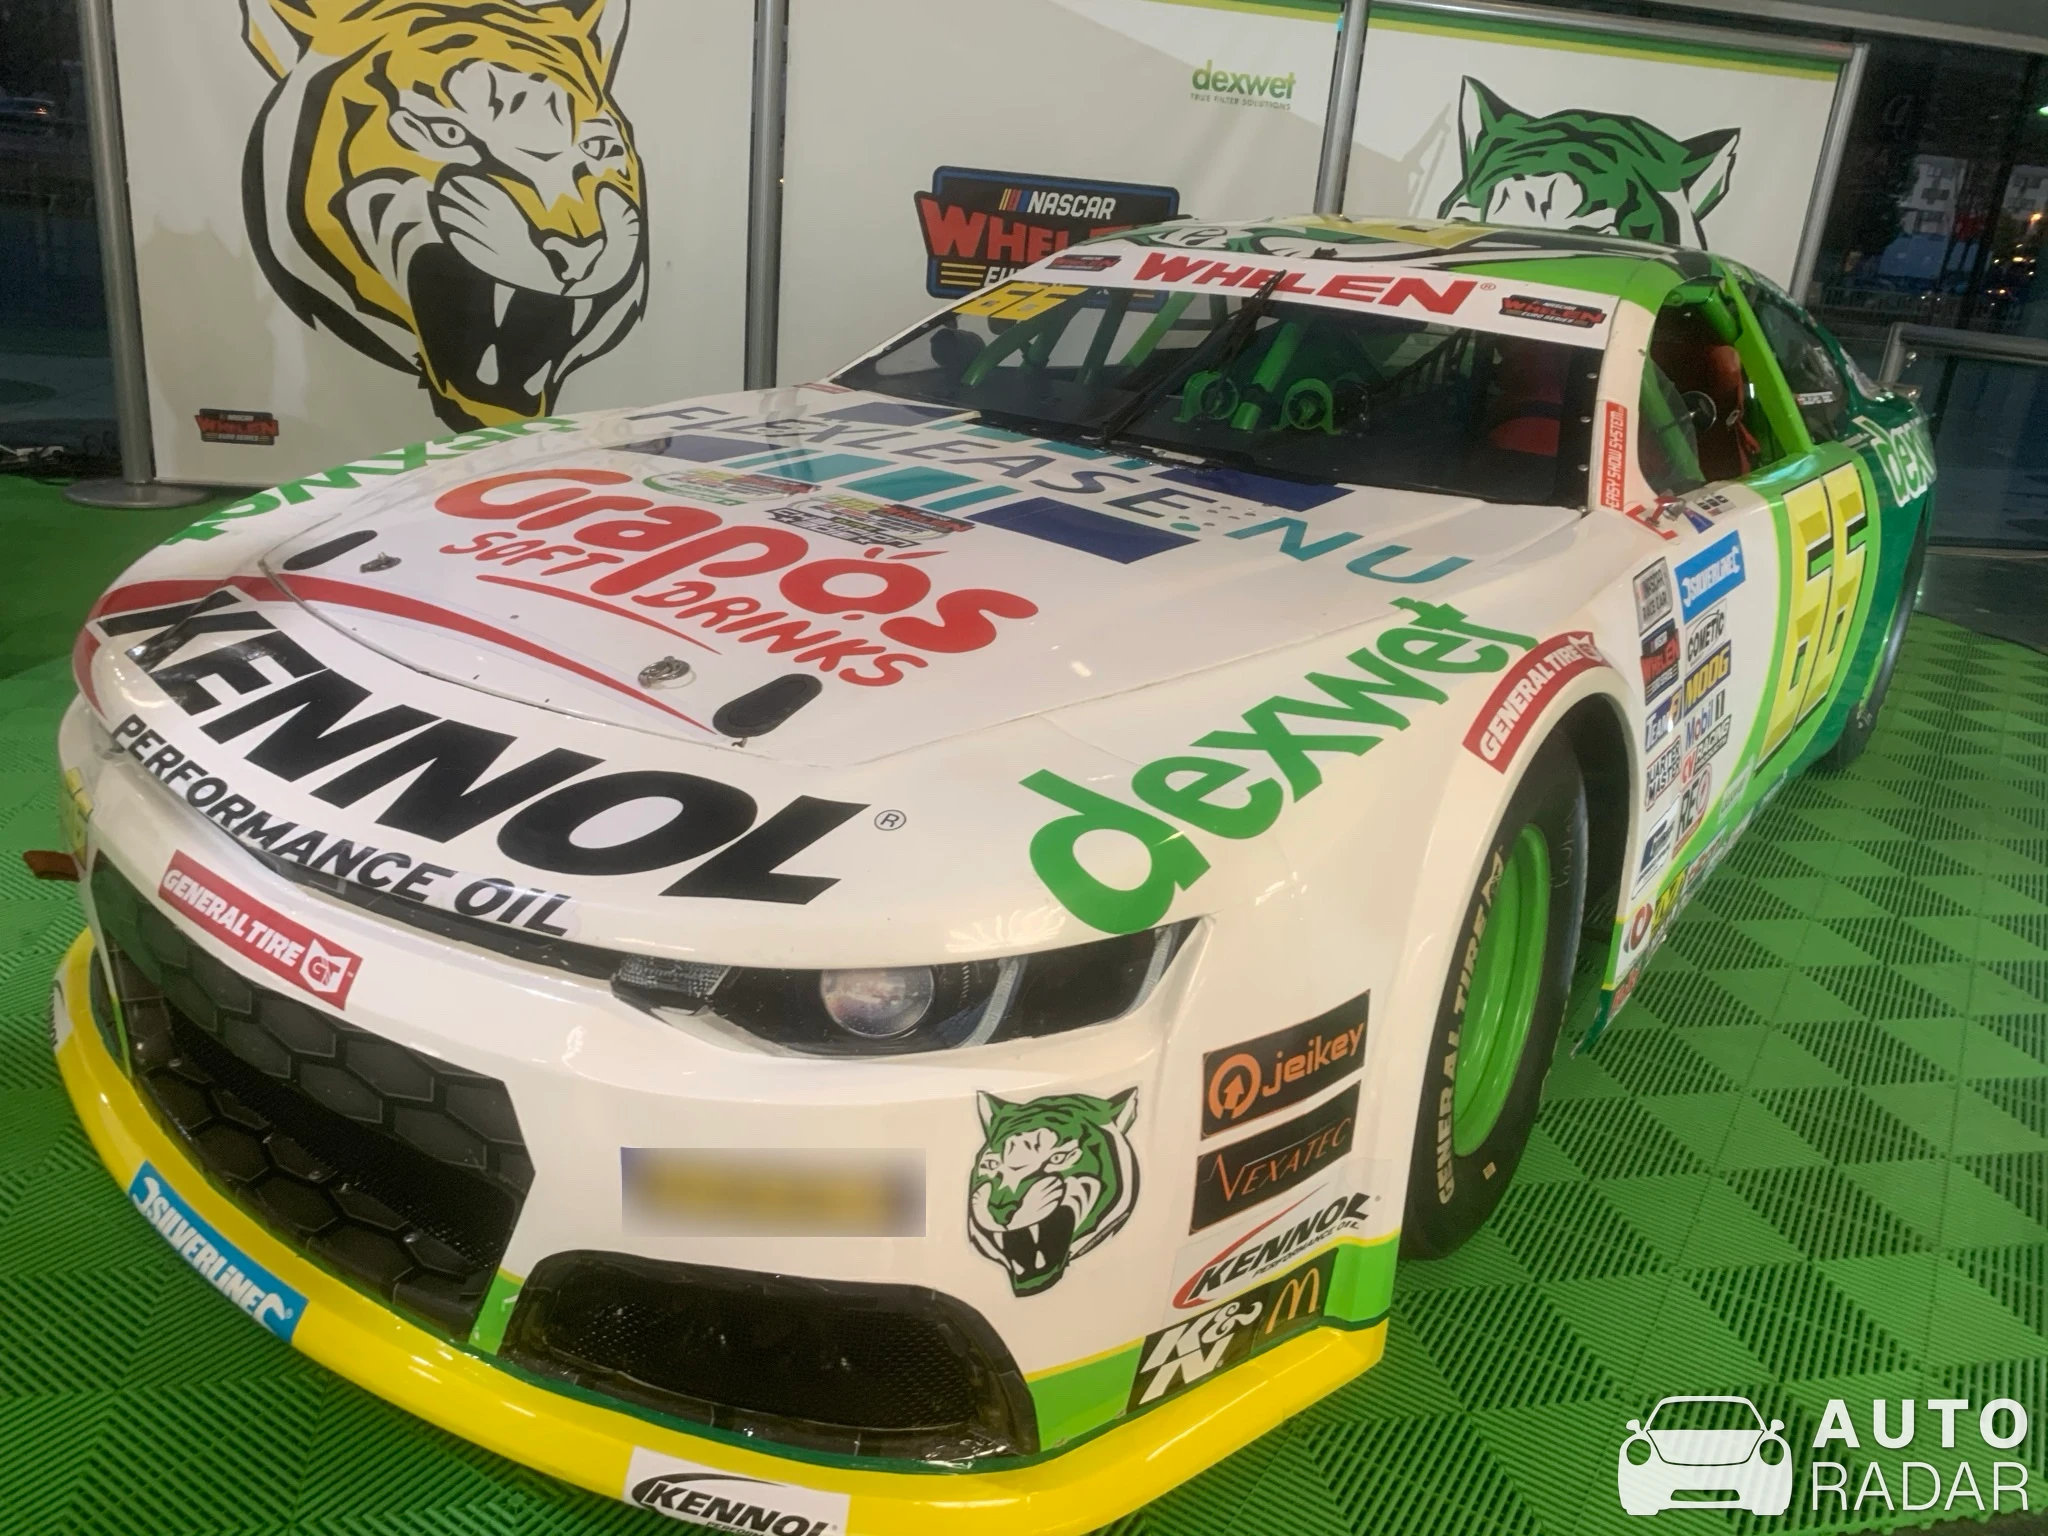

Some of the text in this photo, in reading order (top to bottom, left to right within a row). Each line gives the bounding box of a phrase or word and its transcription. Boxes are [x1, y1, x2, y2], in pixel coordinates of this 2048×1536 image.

[1190, 93, 1291, 111] TRUE FILTER SOLUTIONS
[1192, 59, 1296, 99] dexwet
[920, 197, 1135, 263] WHEL
[1027, 190, 1116, 220] NASCAR
[1133, 252, 1478, 315] WHELEN
[1502, 297, 1606, 324] WHELEN
[1609, 409, 1624, 451] SYSTEM
[1604, 480, 1621, 510] EASY
[1607, 449, 1623, 481] SHOW
[440, 532, 624, 576] SOFT
[632, 581, 930, 686] DRINKS
[1687, 609, 1725, 662] COMETIC
[1755, 460, 1867, 776] 66
[1480, 644, 1584, 761] GENERAL TIRE
[1686, 648, 1731, 708] MOOG
[98, 587, 873, 907] KENNOL
[1686, 699, 1714, 751] Mobil
[1019, 597, 1539, 935] dexwet
[1648, 758, 1681, 801] MASTER
[113, 714, 458, 904] PERFORMANCE
[453, 877, 573, 937] OIL
[163, 868, 249, 938] GENERAL
[244, 919, 305, 967] TIRE
[1262, 1021, 1365, 1098] jeikey
[146, 1193, 268, 1319] SILVERLINE
[1191, 1191, 1372, 1299] KENNOL
[1252, 1220, 1360, 1279] PERFORMANCE OIL
